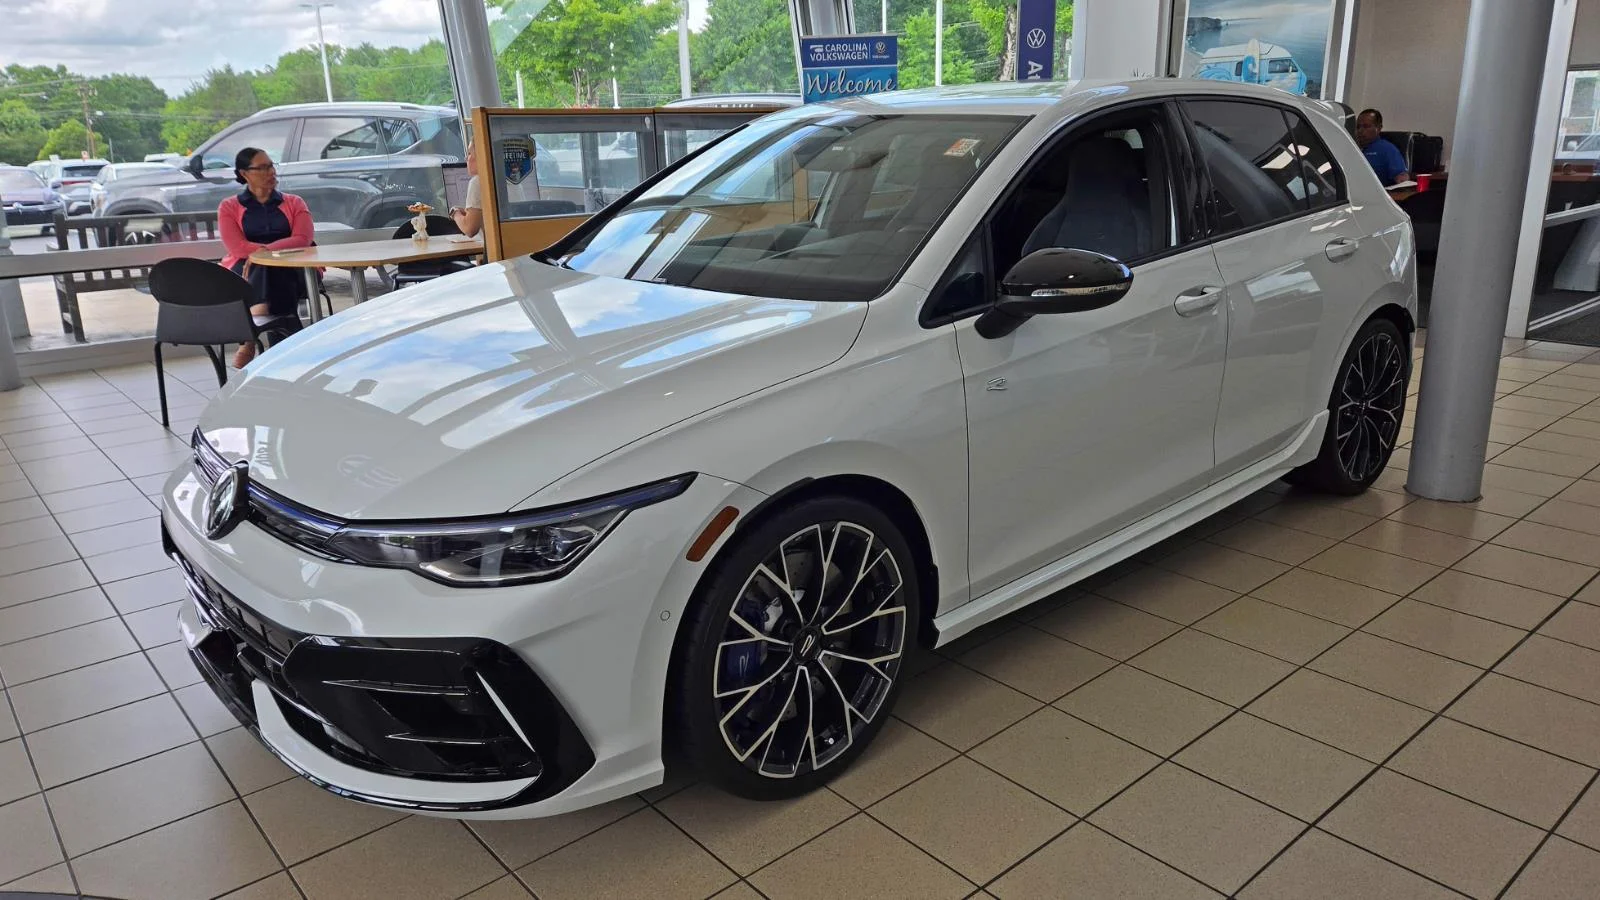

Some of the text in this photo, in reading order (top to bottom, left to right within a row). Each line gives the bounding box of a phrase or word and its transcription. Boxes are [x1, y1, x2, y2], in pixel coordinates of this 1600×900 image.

[825, 43, 868, 52] CAROLINA
[810, 51, 868, 61] VOLKSWAGEN
[806, 68, 896, 95] Welcome
